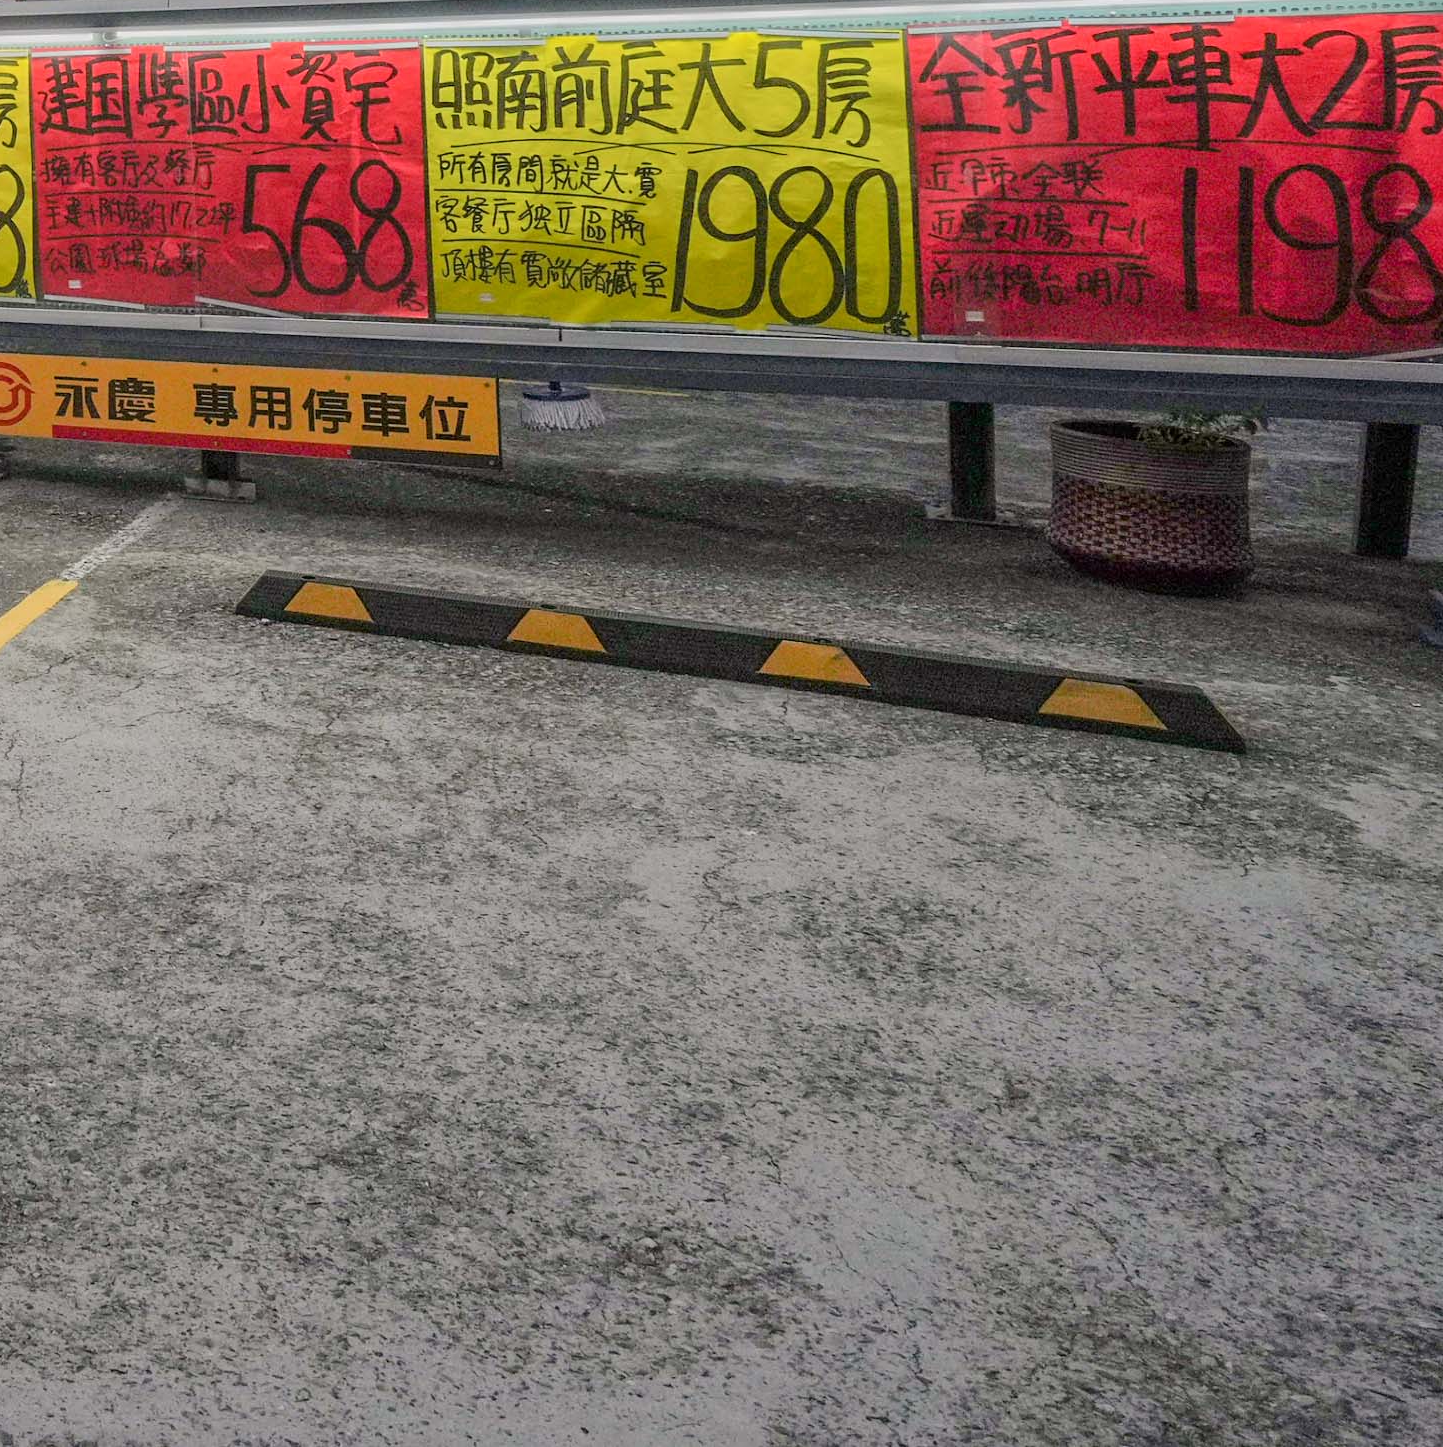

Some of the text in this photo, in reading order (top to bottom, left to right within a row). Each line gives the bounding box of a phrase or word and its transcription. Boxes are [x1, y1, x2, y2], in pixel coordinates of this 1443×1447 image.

[431, 41, 874, 147] 照南前庭大5房
[919, 25, 1443, 152] 全新平車大2房
[242, 159, 413, 298] 568
[671, 165, 901, 325] 1980
[1183, 162, 1443, 327] 1198
[53, 375, 471, 442] 永慶 專用停車位
